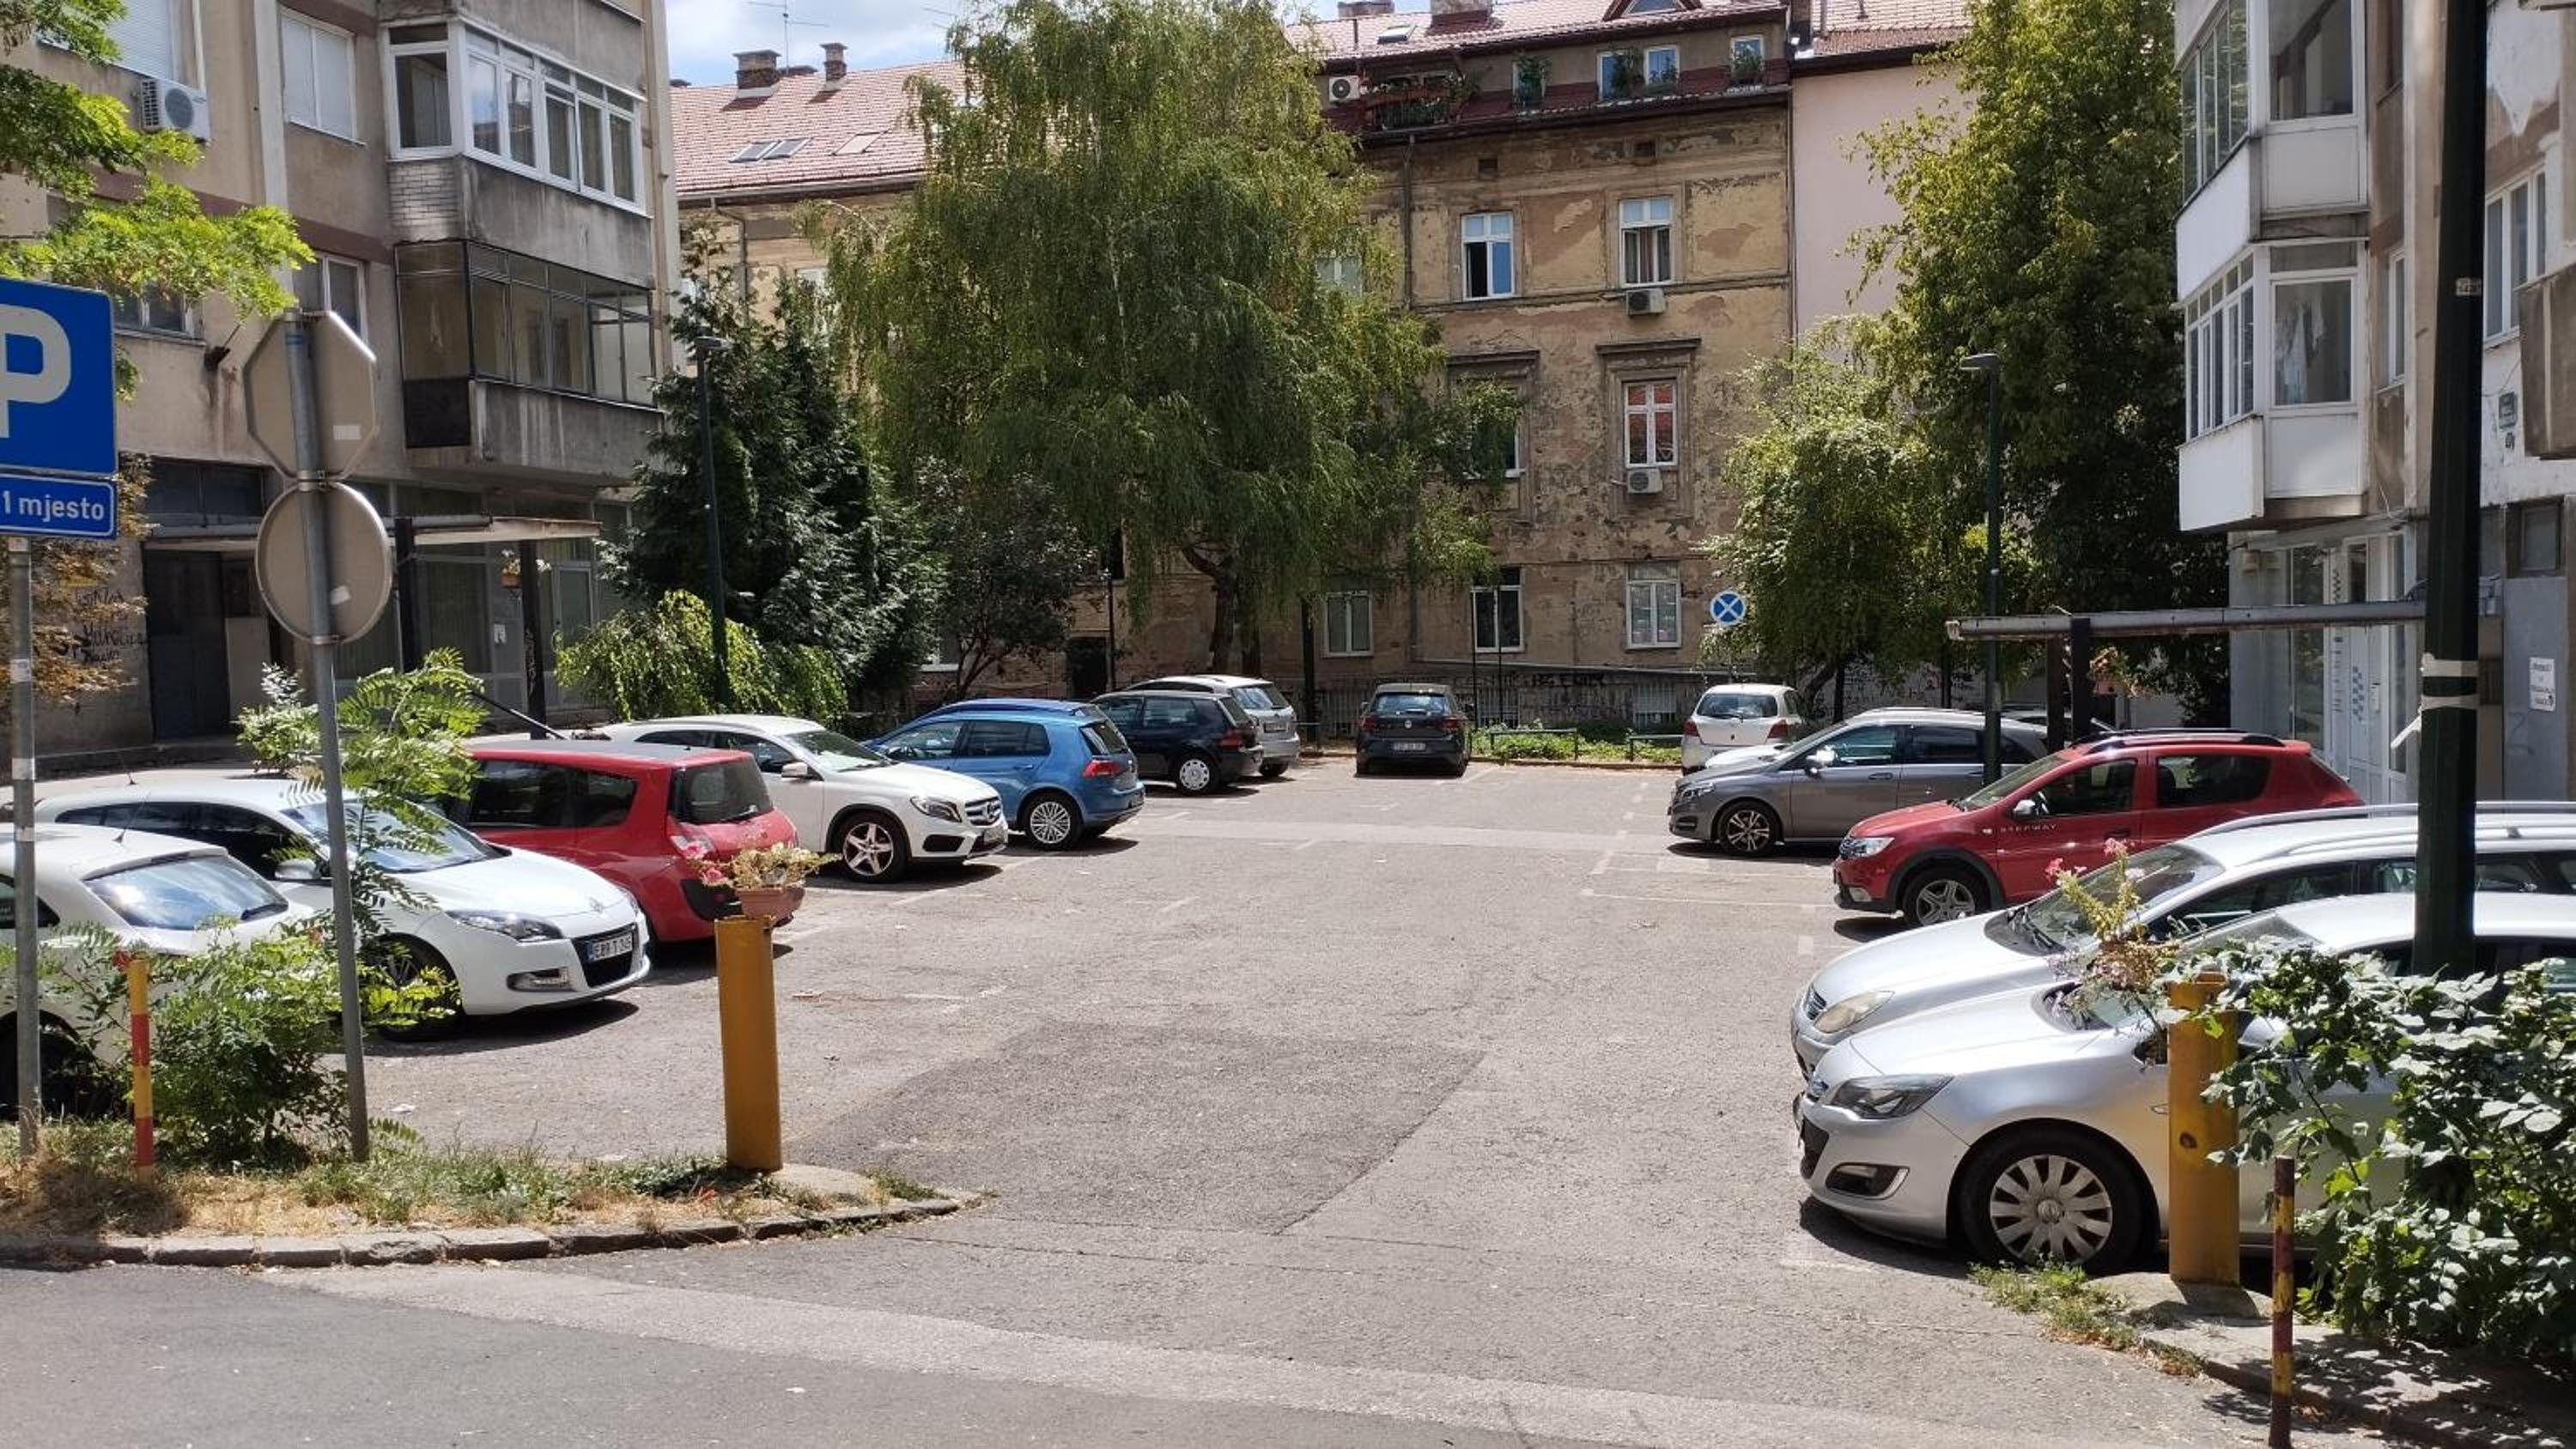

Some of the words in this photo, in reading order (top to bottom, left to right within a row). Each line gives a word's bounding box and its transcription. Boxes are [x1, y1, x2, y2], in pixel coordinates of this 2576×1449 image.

[0, 305, 71, 439] P
[3, 490, 11, 514] 1
[18, 494, 105, 523] mjesto
